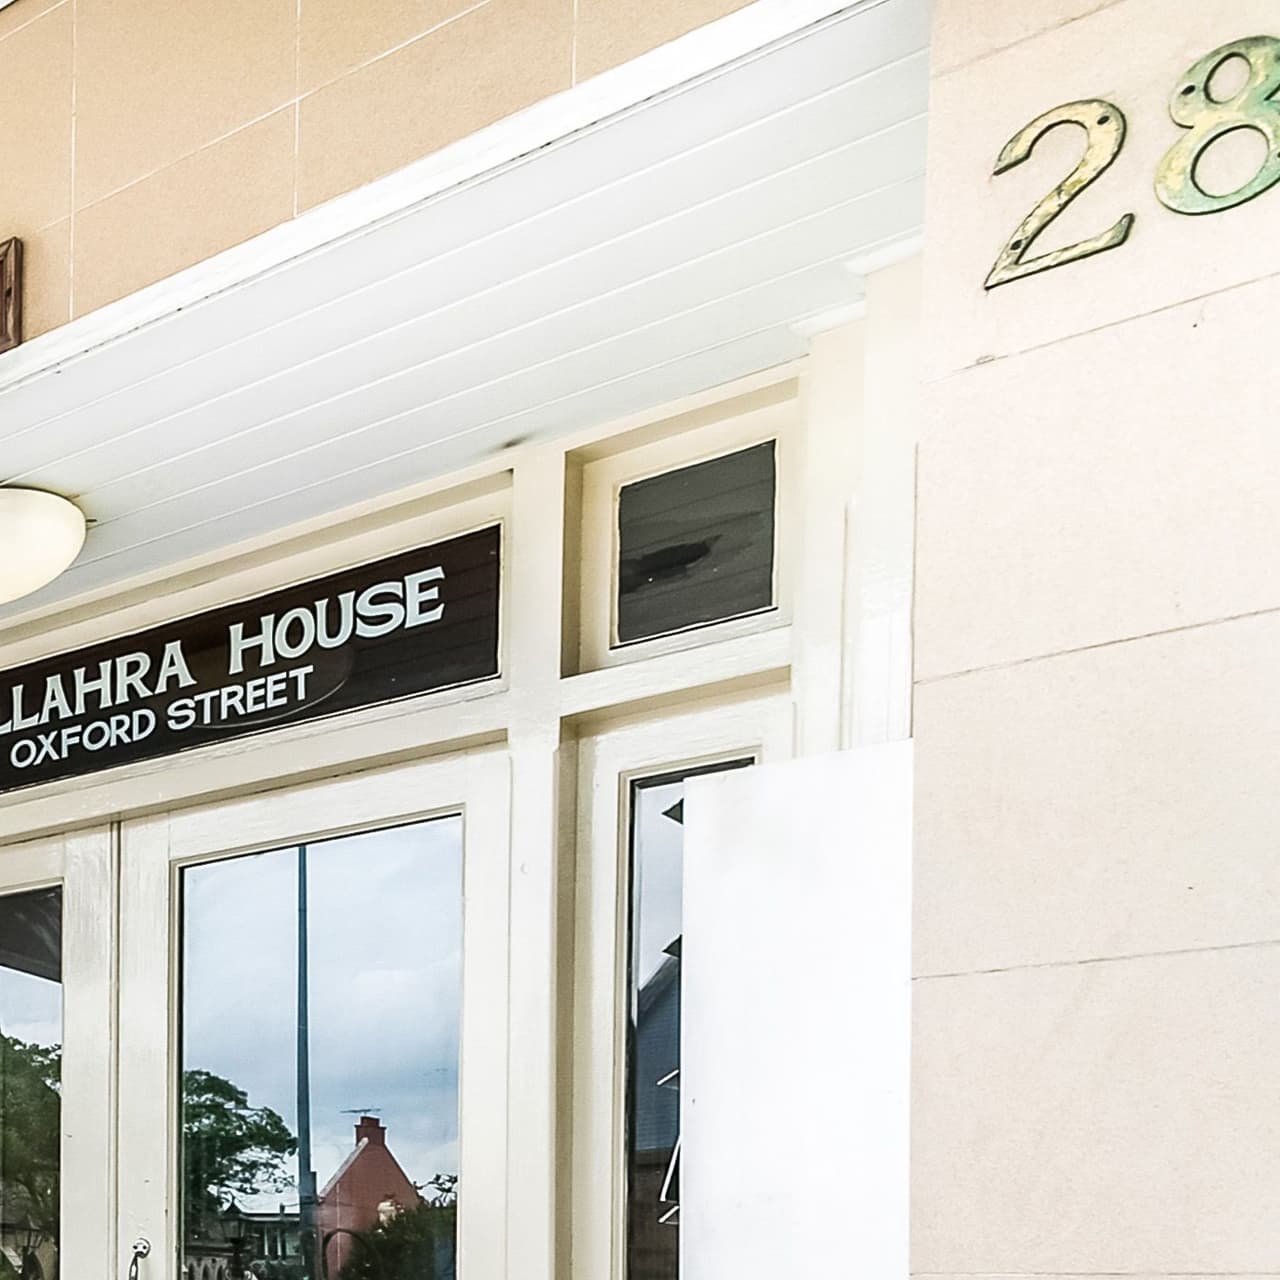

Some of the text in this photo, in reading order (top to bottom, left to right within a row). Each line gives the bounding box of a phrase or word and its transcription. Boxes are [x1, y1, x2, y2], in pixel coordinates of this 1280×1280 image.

[983, 35, 1280, 291] 28
[228, 566, 445, 676] HOUSE
[10, 709, 156, 768] OXFORD
[166, 665, 315, 731] STREET
